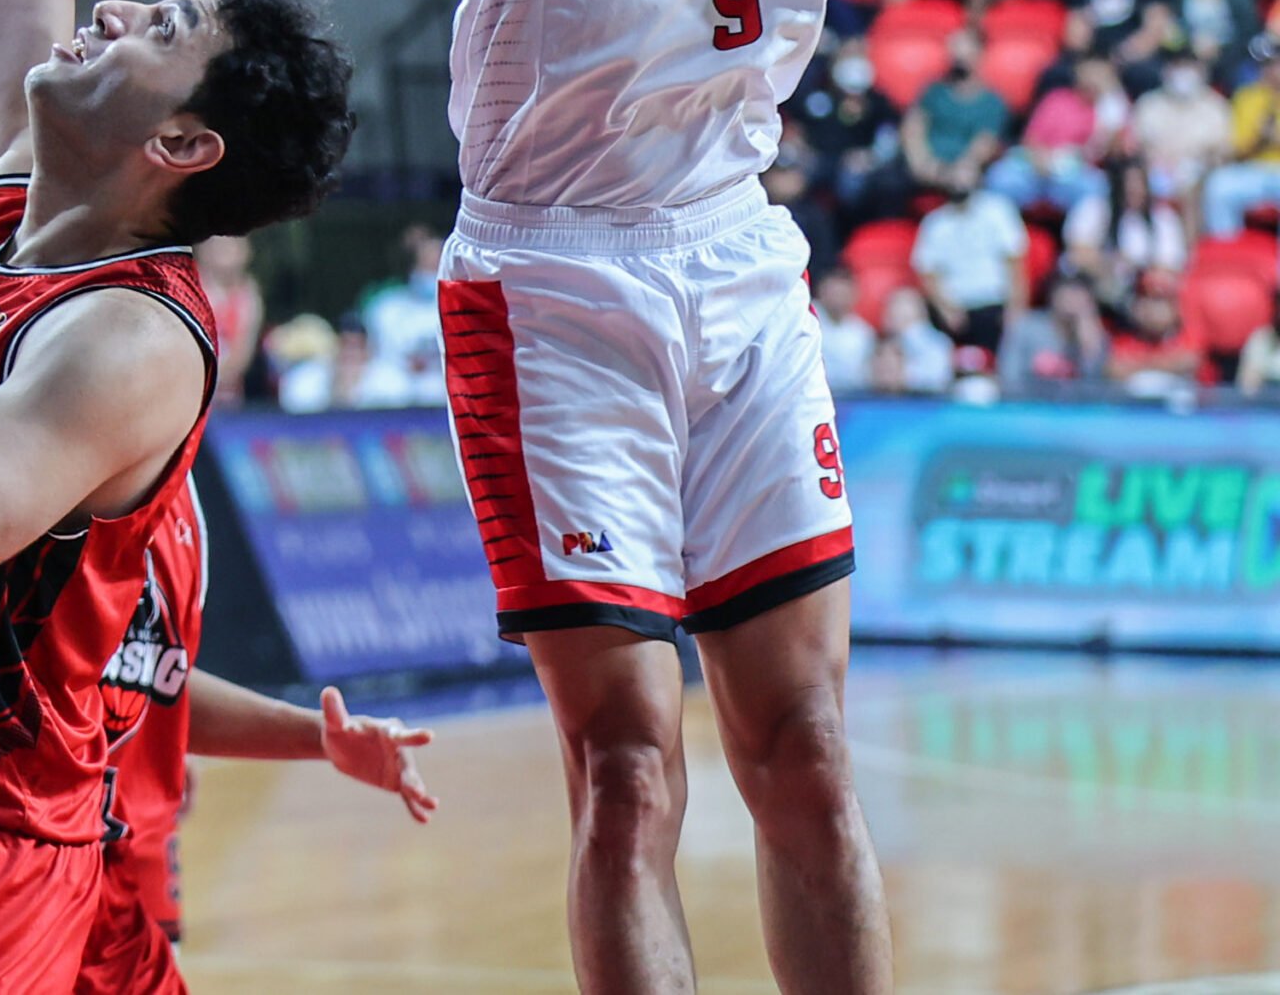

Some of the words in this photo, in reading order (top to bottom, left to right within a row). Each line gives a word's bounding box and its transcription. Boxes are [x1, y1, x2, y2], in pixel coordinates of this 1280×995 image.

[813, 423, 843, 499] 9
[1074, 461, 1250, 532] LIVE
[562, 532, 613, 555] PBA
[920, 517, 1235, 590] STREAM
